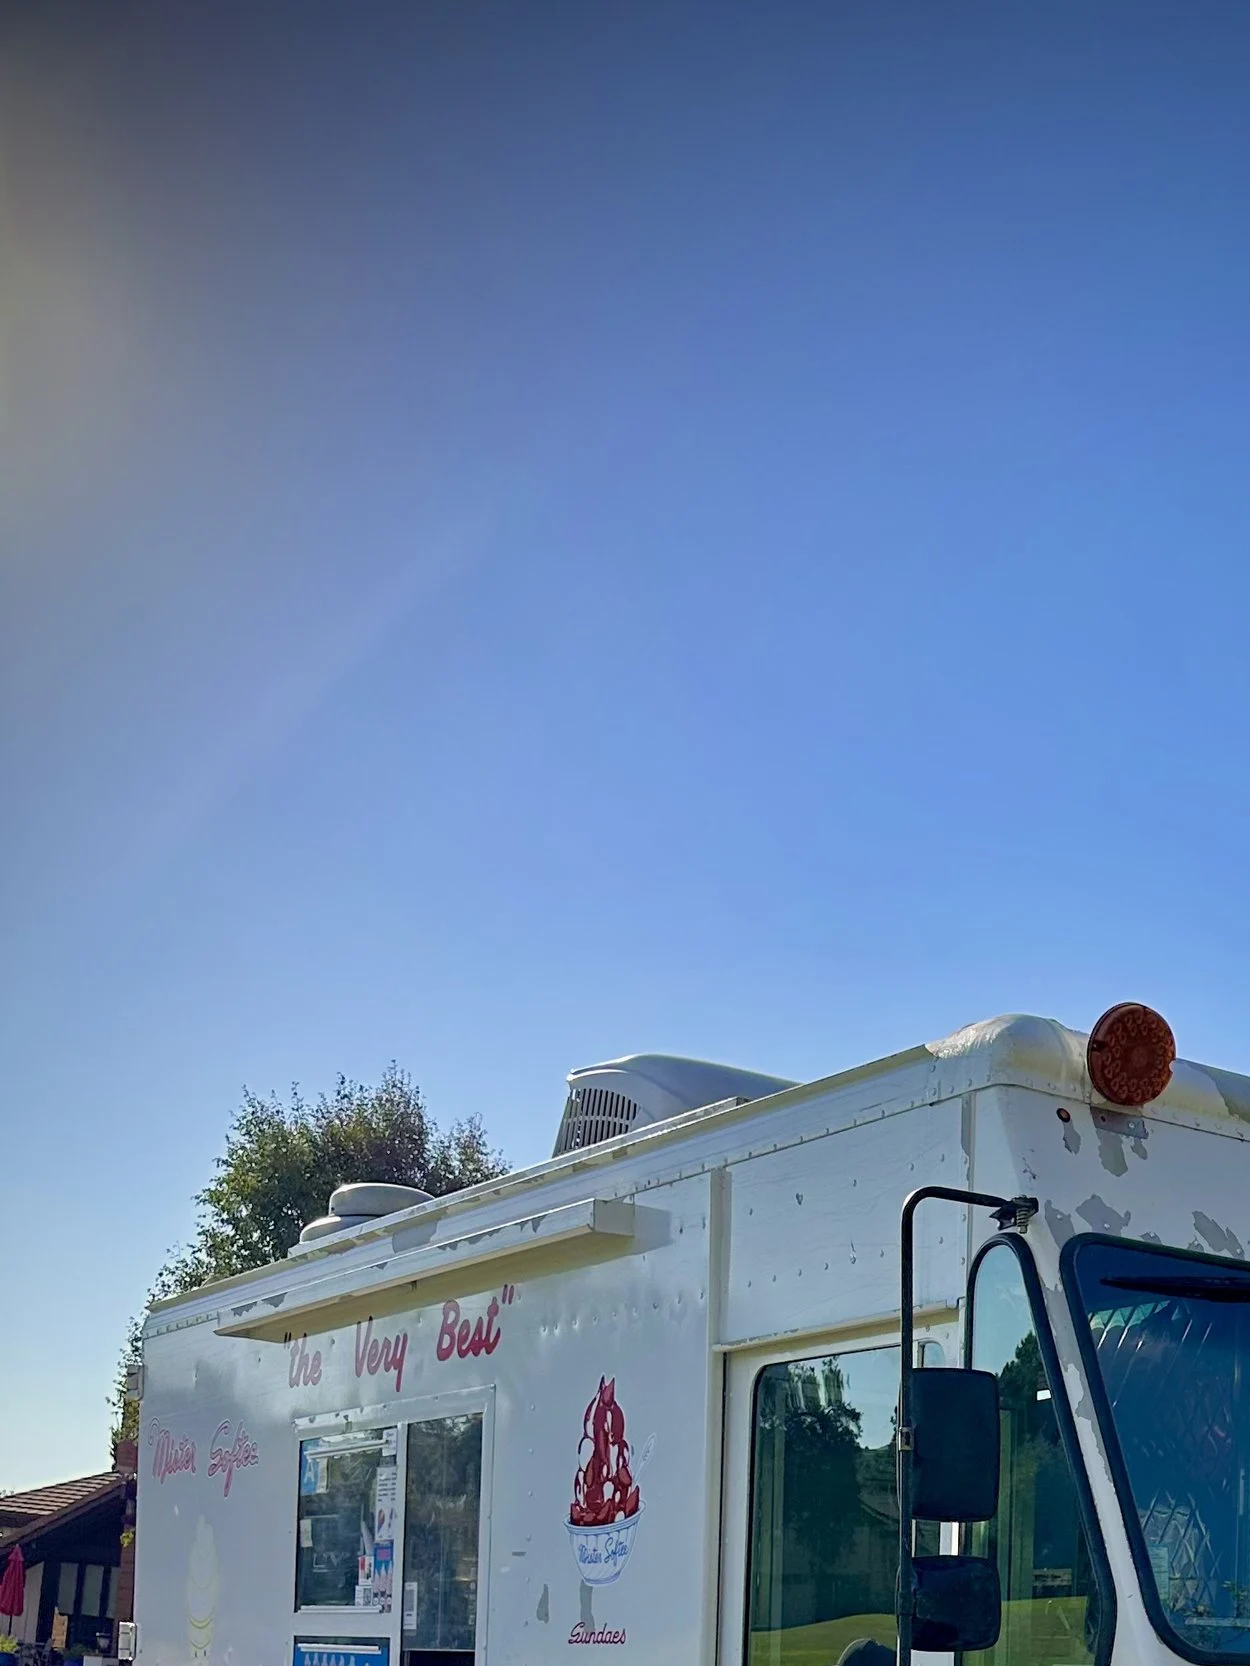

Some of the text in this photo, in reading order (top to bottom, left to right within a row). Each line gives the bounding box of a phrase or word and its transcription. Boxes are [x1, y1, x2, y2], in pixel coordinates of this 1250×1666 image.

[355, 1316, 409, 1393] Very
[436, 1284, 515, 1362] Best"
[148, 1418, 259, 1498] Mister Softee
[604, 1537, 629, 1567] Softee
[568, 1621, 626, 1645] Sundaes
